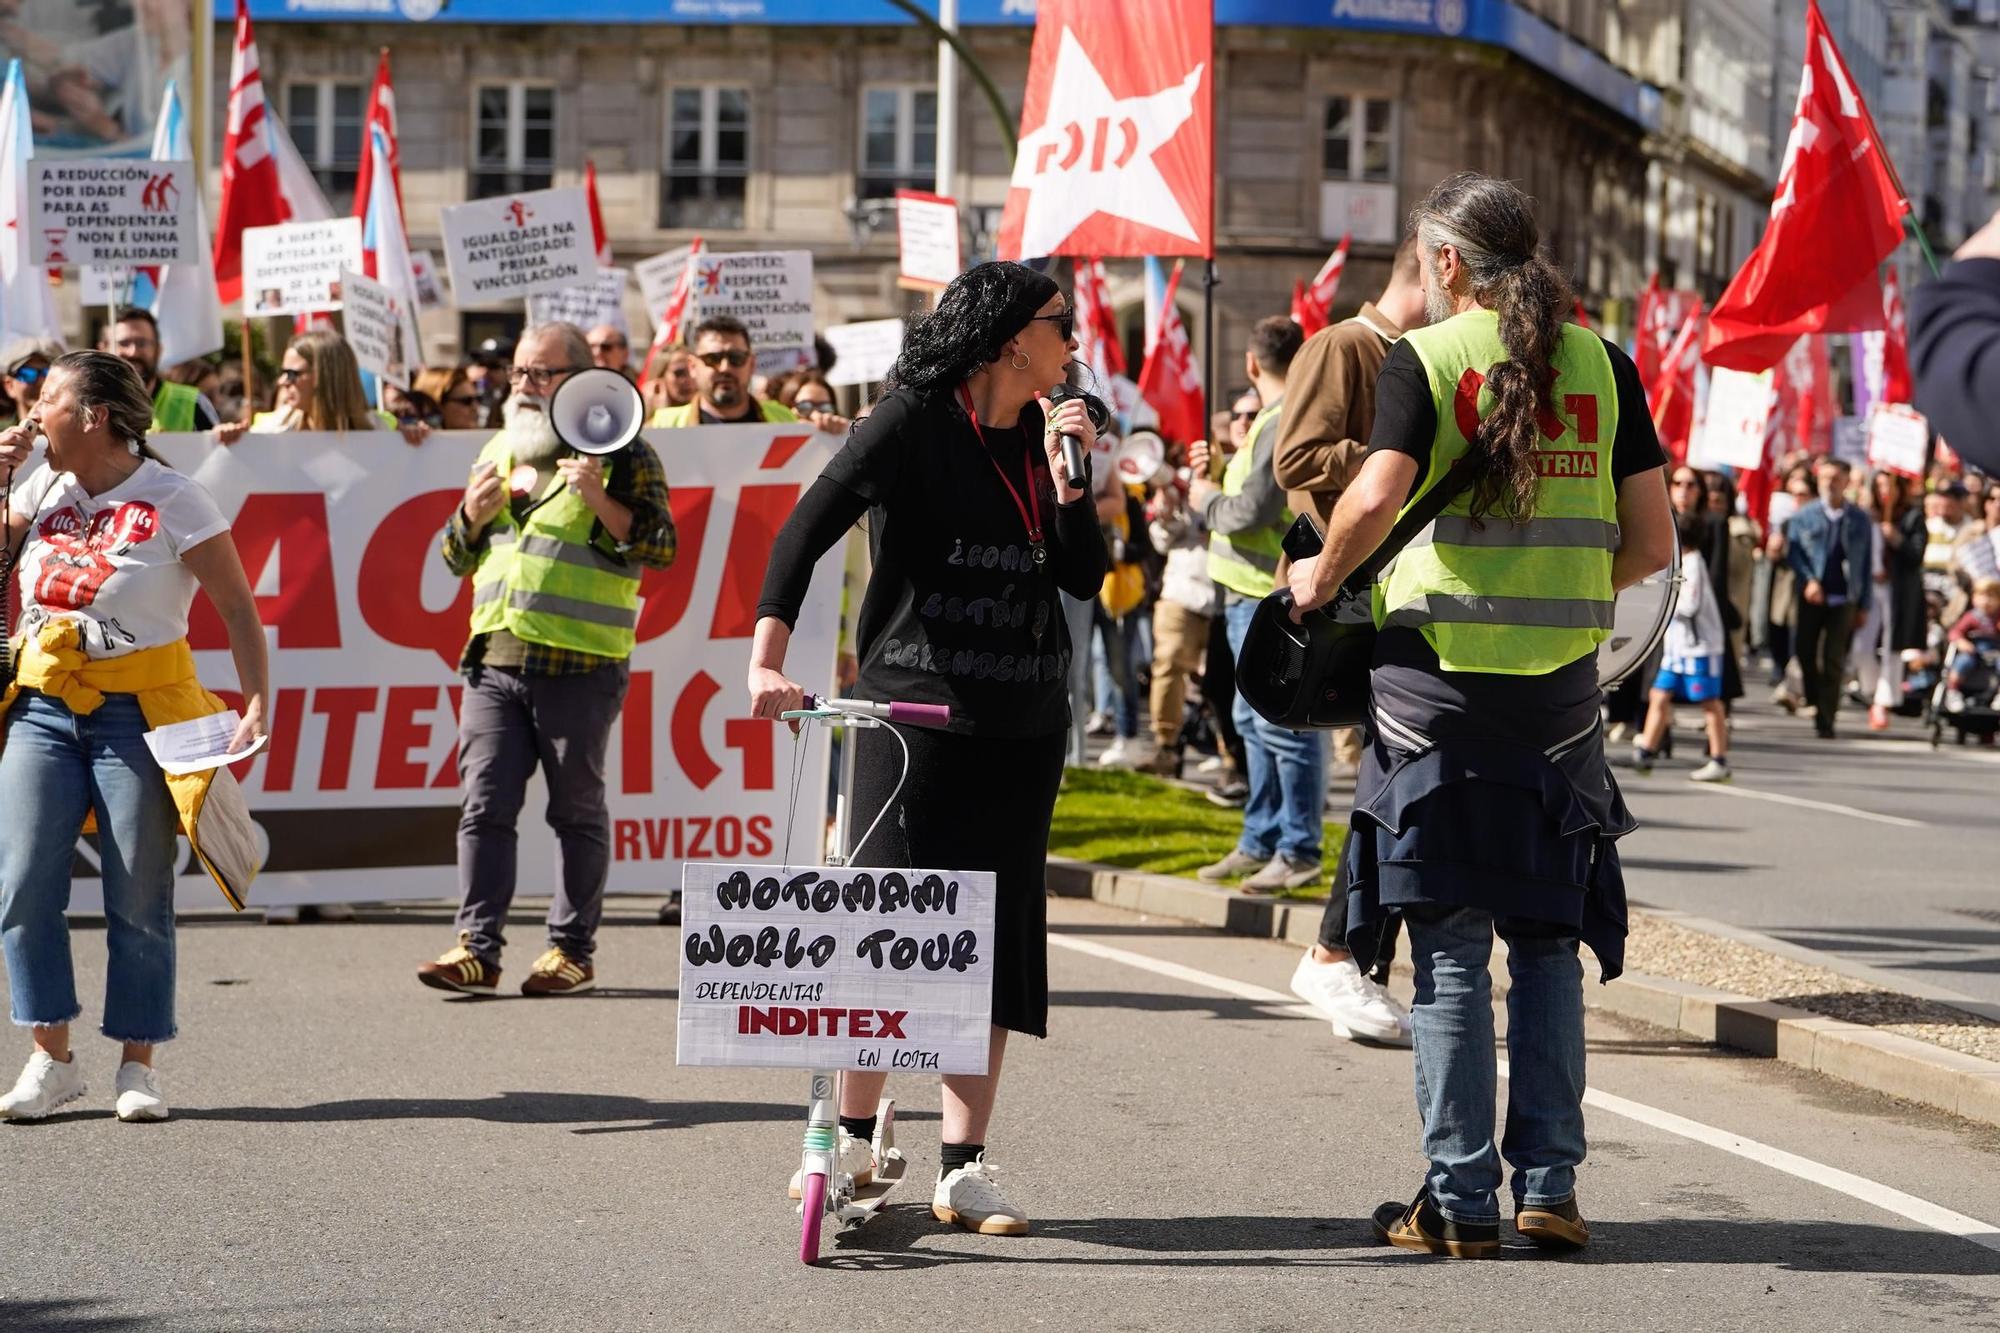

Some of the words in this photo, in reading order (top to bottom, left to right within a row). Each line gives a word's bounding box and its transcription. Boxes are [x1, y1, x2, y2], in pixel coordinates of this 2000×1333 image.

[42, 170, 53, 181] A
[58, 167, 149, 181] REDUCCIÓN
[43, 186, 74, 197] POR
[80, 185, 127, 197] IDADE
[43, 202, 85, 213] PARA
[90, 202, 110, 212] AS
[66, 216, 178, 227] DEPENDENTAS
[77, 232, 114, 243] NON
[119, 230, 127, 243] É
[131, 232, 178, 243] UNHA
[462, 224, 549, 249] IGUALDADE
[553, 221, 576, 235] NA
[93, 248, 178, 259] REALIDADE
[498, 255, 549, 272] PRIMA
[472, 264, 578, 291] VINCULACIÓN
[724, 274, 788, 286] RESPECTA
[733, 290, 741, 300] A
[745, 289, 781, 300] NOSA
[701, 302, 811, 316] REPRESENTACIÓN
[750, 332, 803, 345] CIACIÓN
[1537, 453, 1596, 475] TRIA
[620, 668, 775, 795] IG
[614, 812, 774, 862] RVIZOS
[717, 870, 959, 915] MOTOMAMI
[685, 924, 837, 968] WORLD
[857, 929, 979, 972] TOUR
[696, 981, 823, 1002] DEPENDENTAS
[737, 1005, 909, 1039] INDITEX
[858, 1048, 881, 1067] EN
[892, 1048, 939, 1069] LOITA
